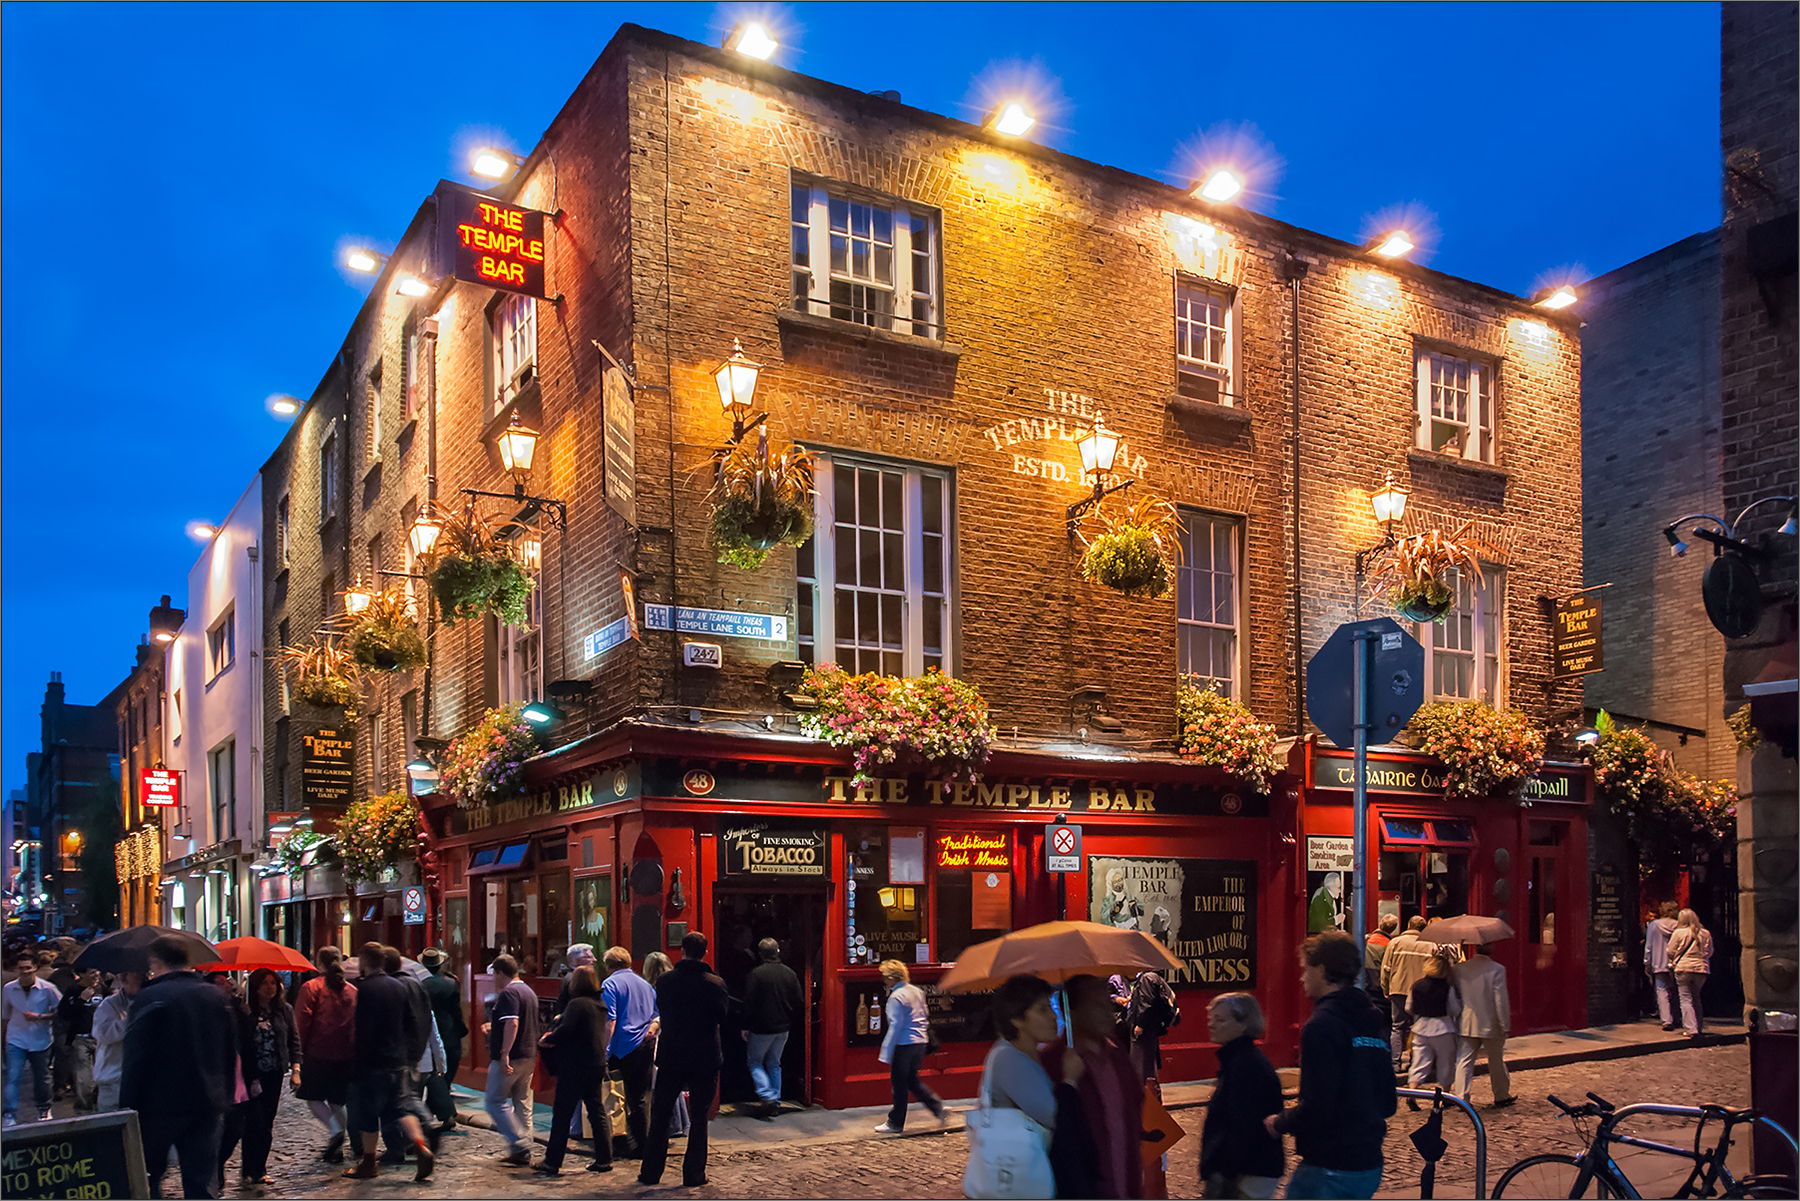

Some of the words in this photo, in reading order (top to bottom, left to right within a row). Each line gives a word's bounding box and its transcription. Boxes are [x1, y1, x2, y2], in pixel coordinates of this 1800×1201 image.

[479, 203, 523, 232] THE
[459, 224, 543, 261] TEMPLE
[482, 256, 524, 284] BAR
[1044, 388, 1094, 418] THE
[1013, 454, 1070, 482] ESTD.
[1115, 443, 1149, 479] AR
[1570, 597, 1584, 607] THE
[697, 611, 706, 620] AN
[742, 616, 764, 627] THEAS
[1558, 607, 1597, 624] TEMPLE
[676, 620, 708, 631] TEMPLE
[711, 623, 734, 633] LANE
[737, 625, 767, 636] SOUTH
[775, 622, 783, 634] 2
[1566, 620, 1588, 633] BAR
[1573, 638, 1597, 649] GARDEN
[1562, 658, 1575, 666] LIVE
[303, 735, 352, 749] TEMPLE
[313, 746, 342, 757] BAR
[323, 768, 352, 776] GARDEN
[689, 774, 709, 789] 48
[825, 776, 909, 804] THE
[925, 778, 1072, 809] TEMPLE
[1087, 786, 1156, 812] BAR
[465, 807, 492, 832] THE
[497, 791, 552, 826] TEMPLE
[558, 780, 594, 811] BAR
[763, 837, 780, 845] FINE
[781, 837, 815, 846] SMOKING
[940, 834, 1006, 851] Traditional
[1310, 840, 1324, 850] Beer
[1326, 841, 1349, 850] Garden
[735, 841, 815, 870] TOBACCO
[939, 850, 969, 866] Irish
[975, 850, 1009, 866] Music
[1310, 850, 1336, 861] Smoking
[753, 865, 783, 873] Always
[797, 865, 821, 873] Stock
[1315, 861, 1330, 869] Area
[1140, 880, 1168, 895] BAR
[1223, 877, 1246, 893] THE
[1194, 895, 1246, 912] EMPEROR
[1232, 915, 1246, 930] OF
[864, 932, 888, 941] LIVE
[890, 931, 918, 941] MUSIC
[878, 943, 906, 953] DAILY
[1171, 940, 1205, 957] ALTED
[1206, 932, 1248, 953] LIQUORS
[2, 1142, 73, 1170] MEXICO
[2, 1172, 30, 1192] TO
[37, 1158, 96, 1187] ROME
[66, 1181, 112, 1200] BIRD
